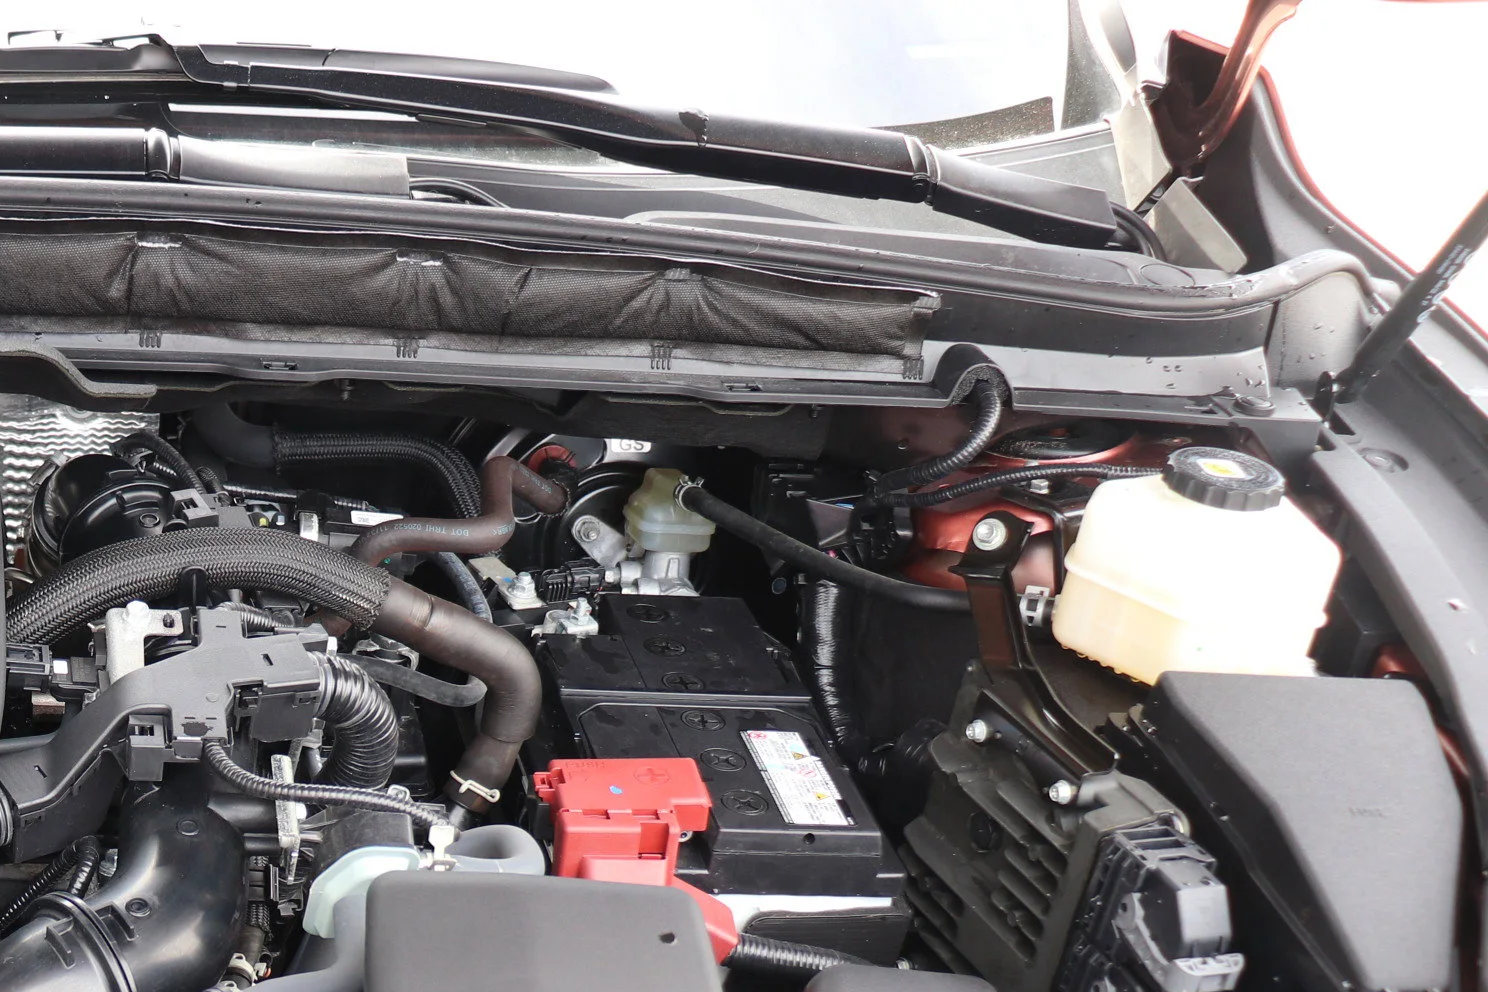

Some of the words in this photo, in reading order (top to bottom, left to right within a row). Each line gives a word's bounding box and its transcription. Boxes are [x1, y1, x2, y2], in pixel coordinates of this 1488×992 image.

[619, 439, 645, 451] GS
[425, 524, 448, 535] TRHI
[450, 529, 469, 537] DOT
